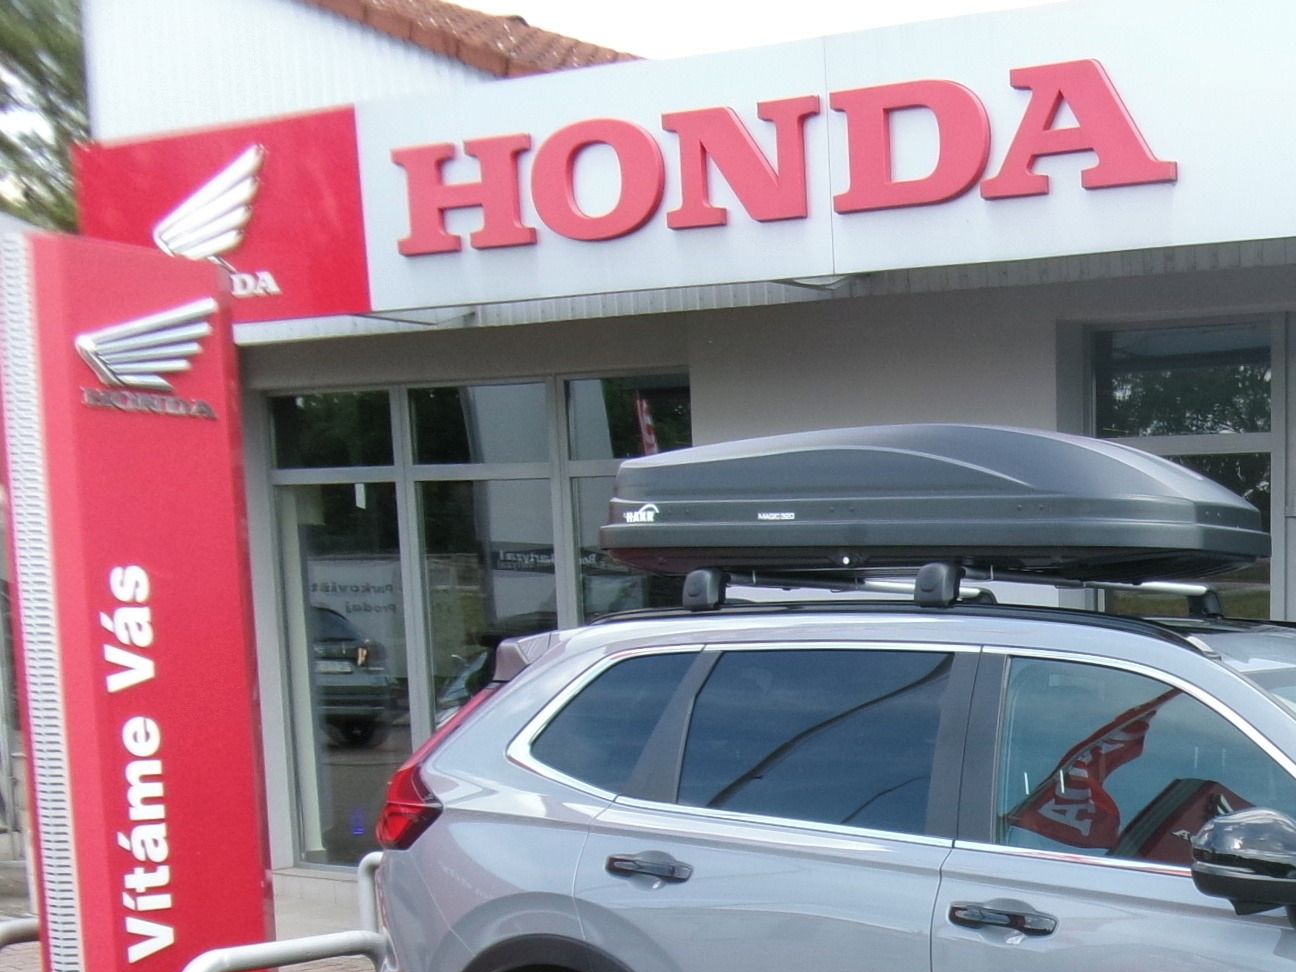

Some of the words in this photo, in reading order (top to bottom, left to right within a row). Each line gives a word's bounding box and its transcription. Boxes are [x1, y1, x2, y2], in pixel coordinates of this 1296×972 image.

[391, 58, 1178, 256] HONDA
[81, 386, 218, 420] HONDA
[100, 565, 155, 693] Vás
[117, 716, 175, 964] Vítáme
